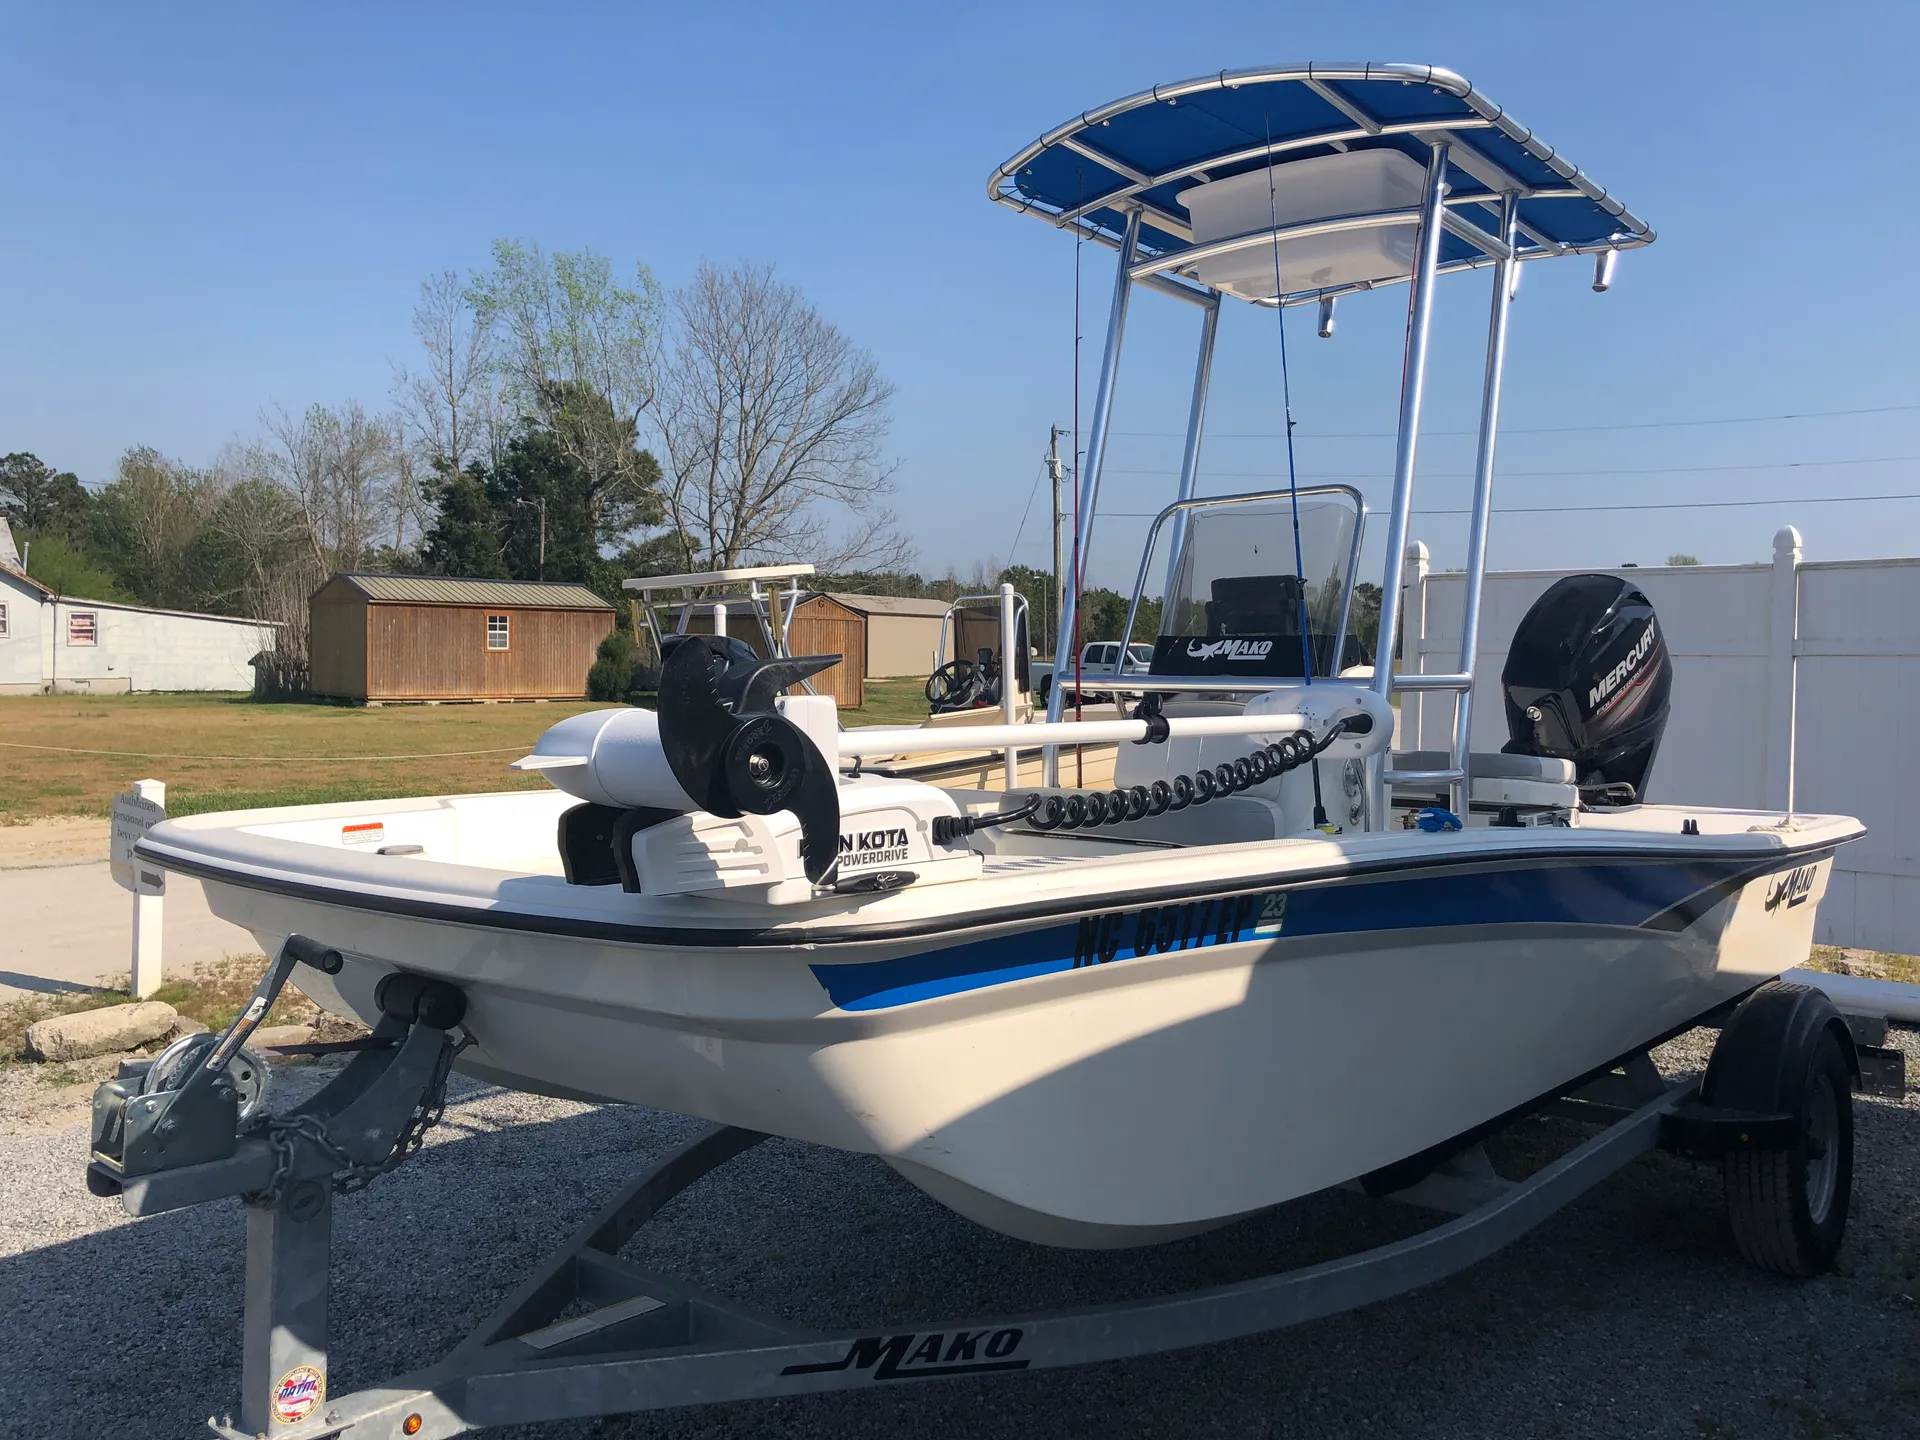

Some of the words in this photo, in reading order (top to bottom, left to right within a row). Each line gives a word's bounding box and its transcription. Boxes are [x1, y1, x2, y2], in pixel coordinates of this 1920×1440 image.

[1214, 639, 1273, 661] MAKO
[1589, 616, 1655, 709] MERCURY
[120, 793, 156, 812] Authorized
[113, 810, 143, 828] personnel
[858, 828, 909, 851] KOTA
[838, 847, 909, 867] POWERDRIVE
[1782, 864, 1818, 909] MAKO
[1261, 893, 1287, 918] 23
[1073, 911, 1123, 969] NC
[780, 1328, 1031, 1380] MAKO
